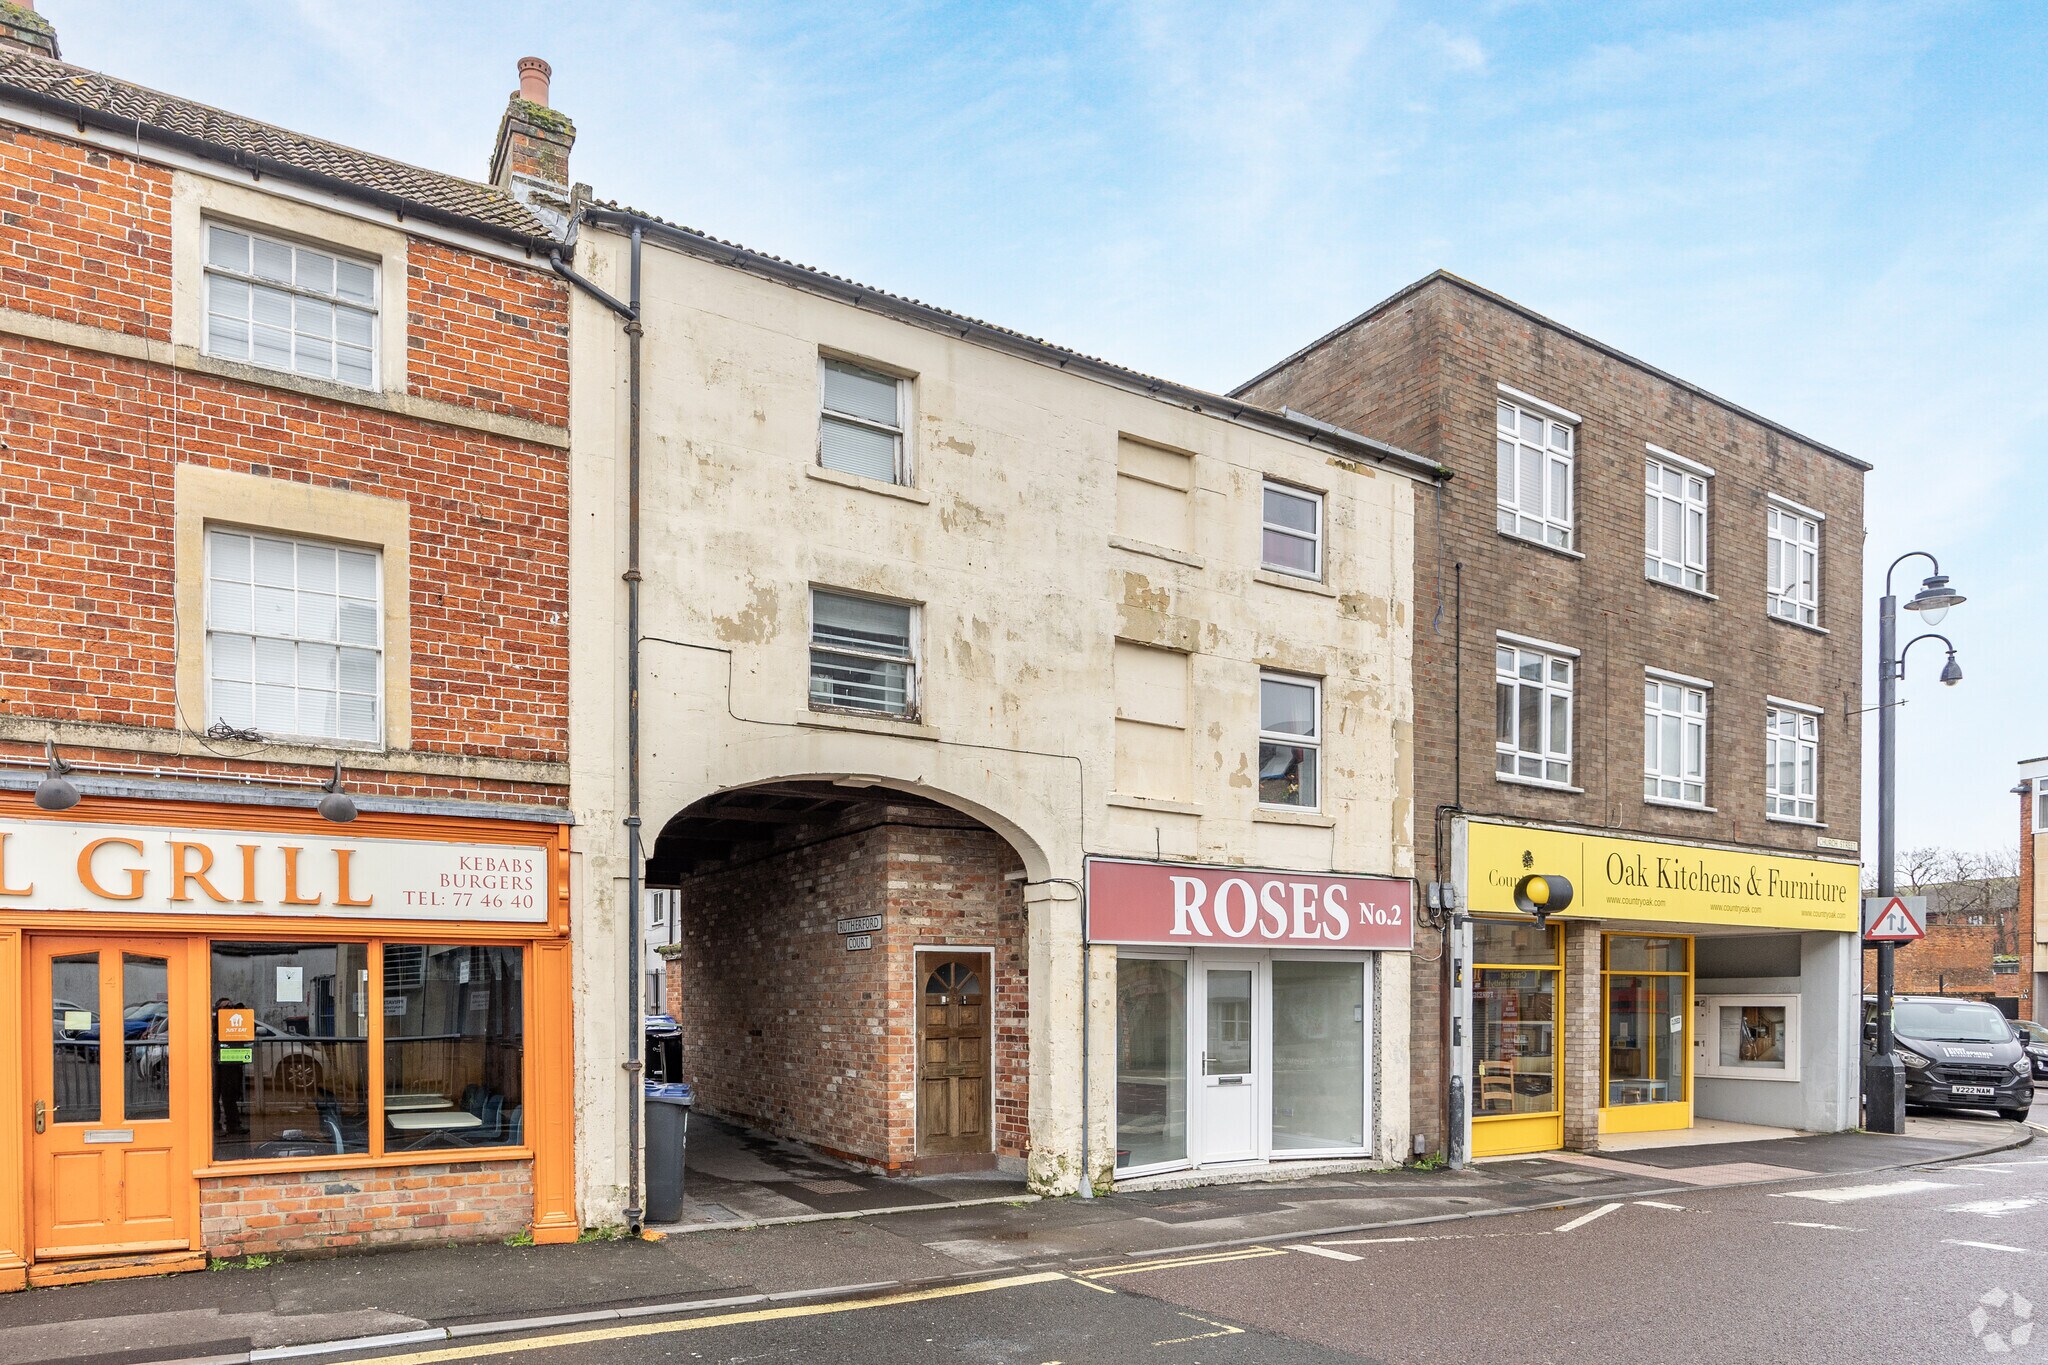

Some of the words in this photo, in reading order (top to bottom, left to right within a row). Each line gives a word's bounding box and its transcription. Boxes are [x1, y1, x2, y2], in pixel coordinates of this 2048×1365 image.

[1819, 838, 1838, 848] CHURCH
[1840, 840, 1857, 850] STREET
[77, 837, 374, 907] GRILL
[459, 856, 533, 873] KEBABS
[440, 873, 533, 890] BURGERS
[1606, 852, 1649, 887] Oak
[1656, 857, 1741, 895] Kitchens
[1746, 865, 1762, 897] &
[1768, 868, 1847, 903] Furniture
[403, 891, 445, 906] TEL:
[453, 893, 473, 907] 77
[480, 894, 503, 908] 46
[511, 895, 533, 909] 40
[1169, 876, 1350, 941] ROSES
[1358, 902, 1402, 926] No.2
[1606, 895, 1666, 908] www.countryoak.com
[1710, 903, 1762, 915] www.countryoak.com
[840, 917, 879, 932] RUTHERFORD
[849, 936, 869, 949] COURT
